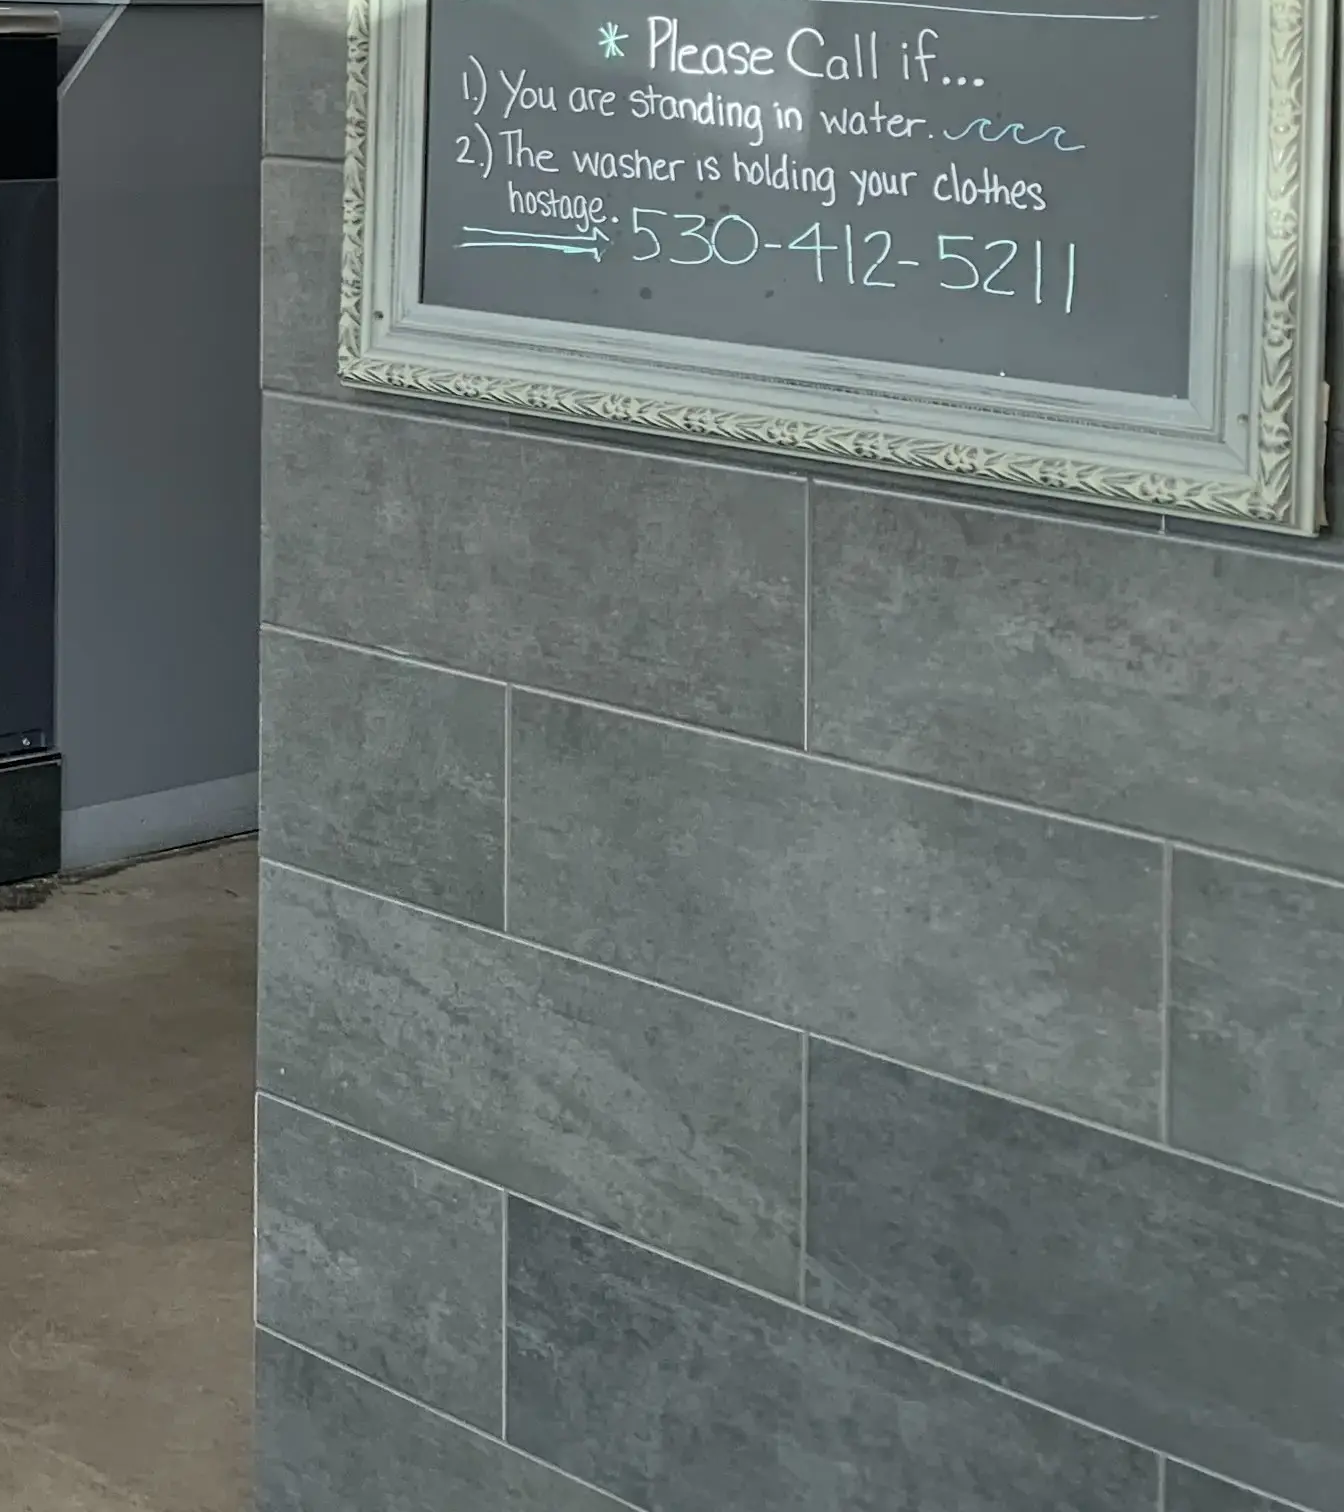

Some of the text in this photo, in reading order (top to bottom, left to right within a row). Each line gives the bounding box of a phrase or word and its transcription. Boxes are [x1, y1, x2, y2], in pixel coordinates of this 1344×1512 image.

[647, 15, 775, 75] Please
[786, 26, 878, 81] Call
[498, 68, 558, 119] You
[568, 87, 616, 117] are
[629, 84, 763, 146] standing
[772, 101, 804, 131] in
[819, 100, 934, 139] water.
[498, 128, 560, 172] The
[572, 149, 685, 182] washer
[696, 155, 721, 181] is
[733, 151, 837, 208] holding
[849, 169, 918, 206] your
[933, 161, 1047, 211] clothes
[508, 180, 620, 233] hostage.
[631, 206, 1076, 314] 530-412-5211
